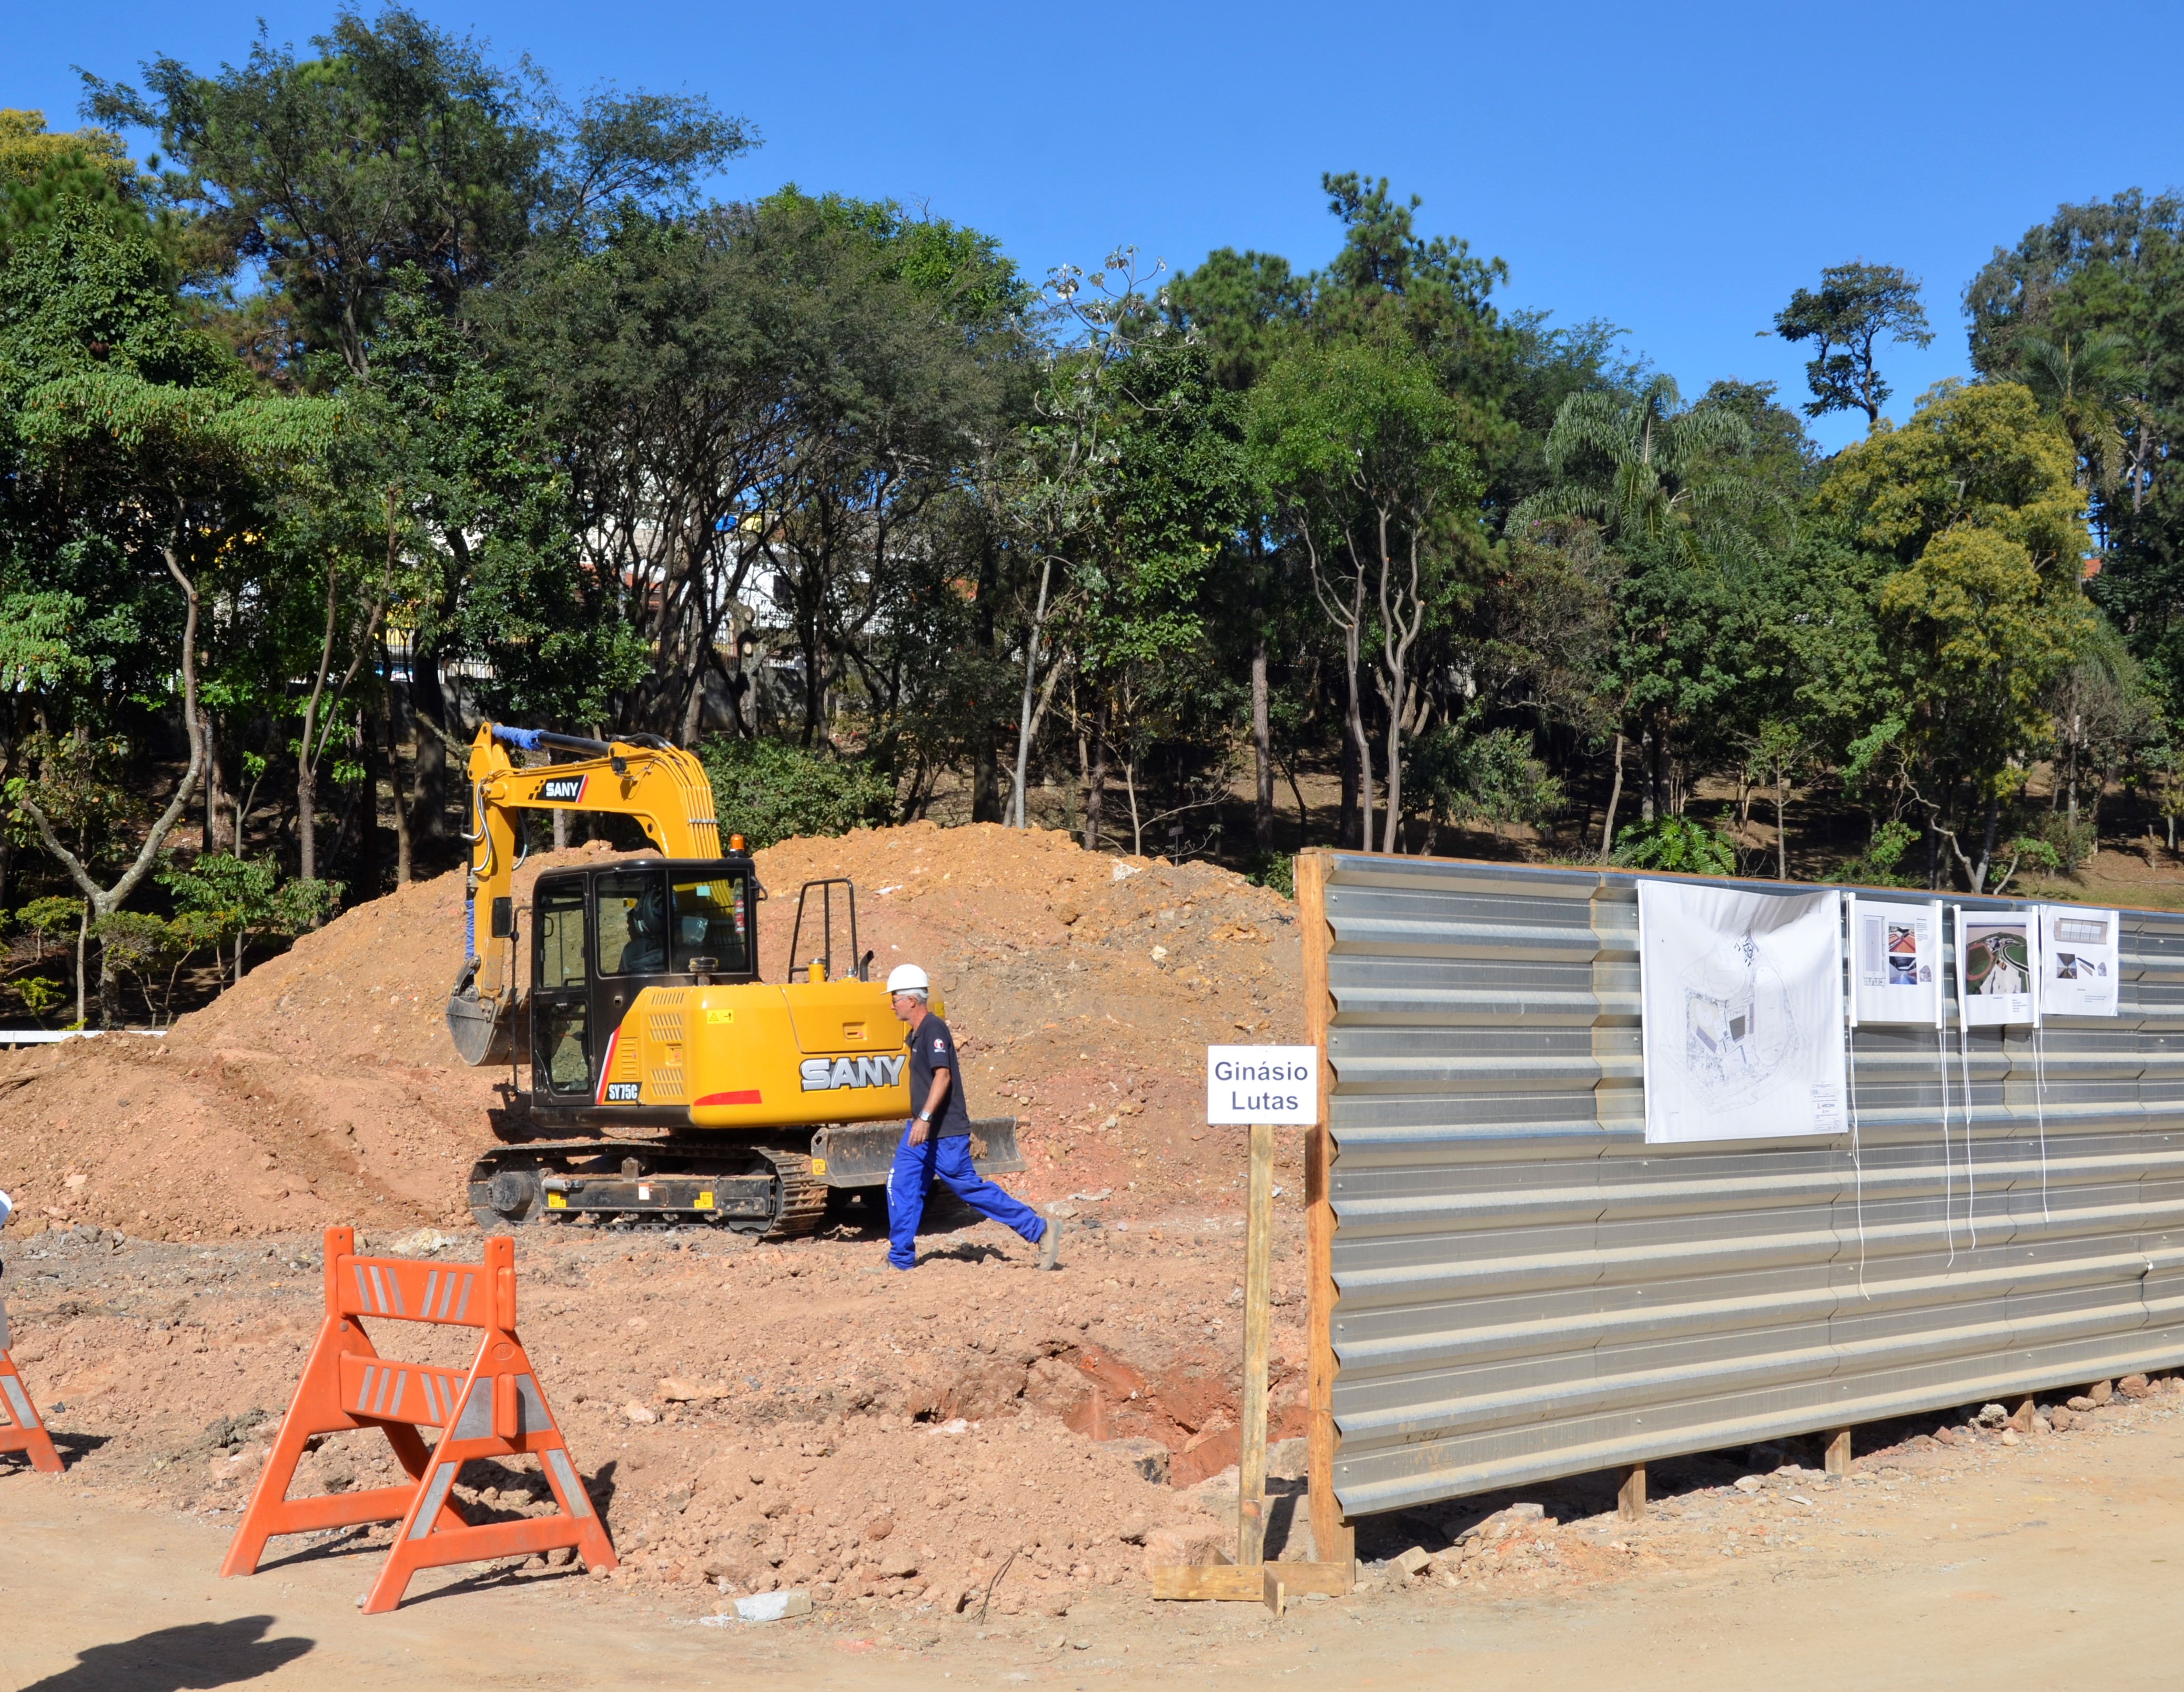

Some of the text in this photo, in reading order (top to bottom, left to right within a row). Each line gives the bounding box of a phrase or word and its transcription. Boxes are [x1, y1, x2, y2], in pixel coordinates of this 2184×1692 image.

[545, 782, 579, 797] SANY
[800, 1054, 907, 1091] SANY
[1215, 1061, 1308, 1081] Ginásio
[609, 1084, 638, 1100] SY75C
[1232, 1091, 1298, 1110] Lutas
